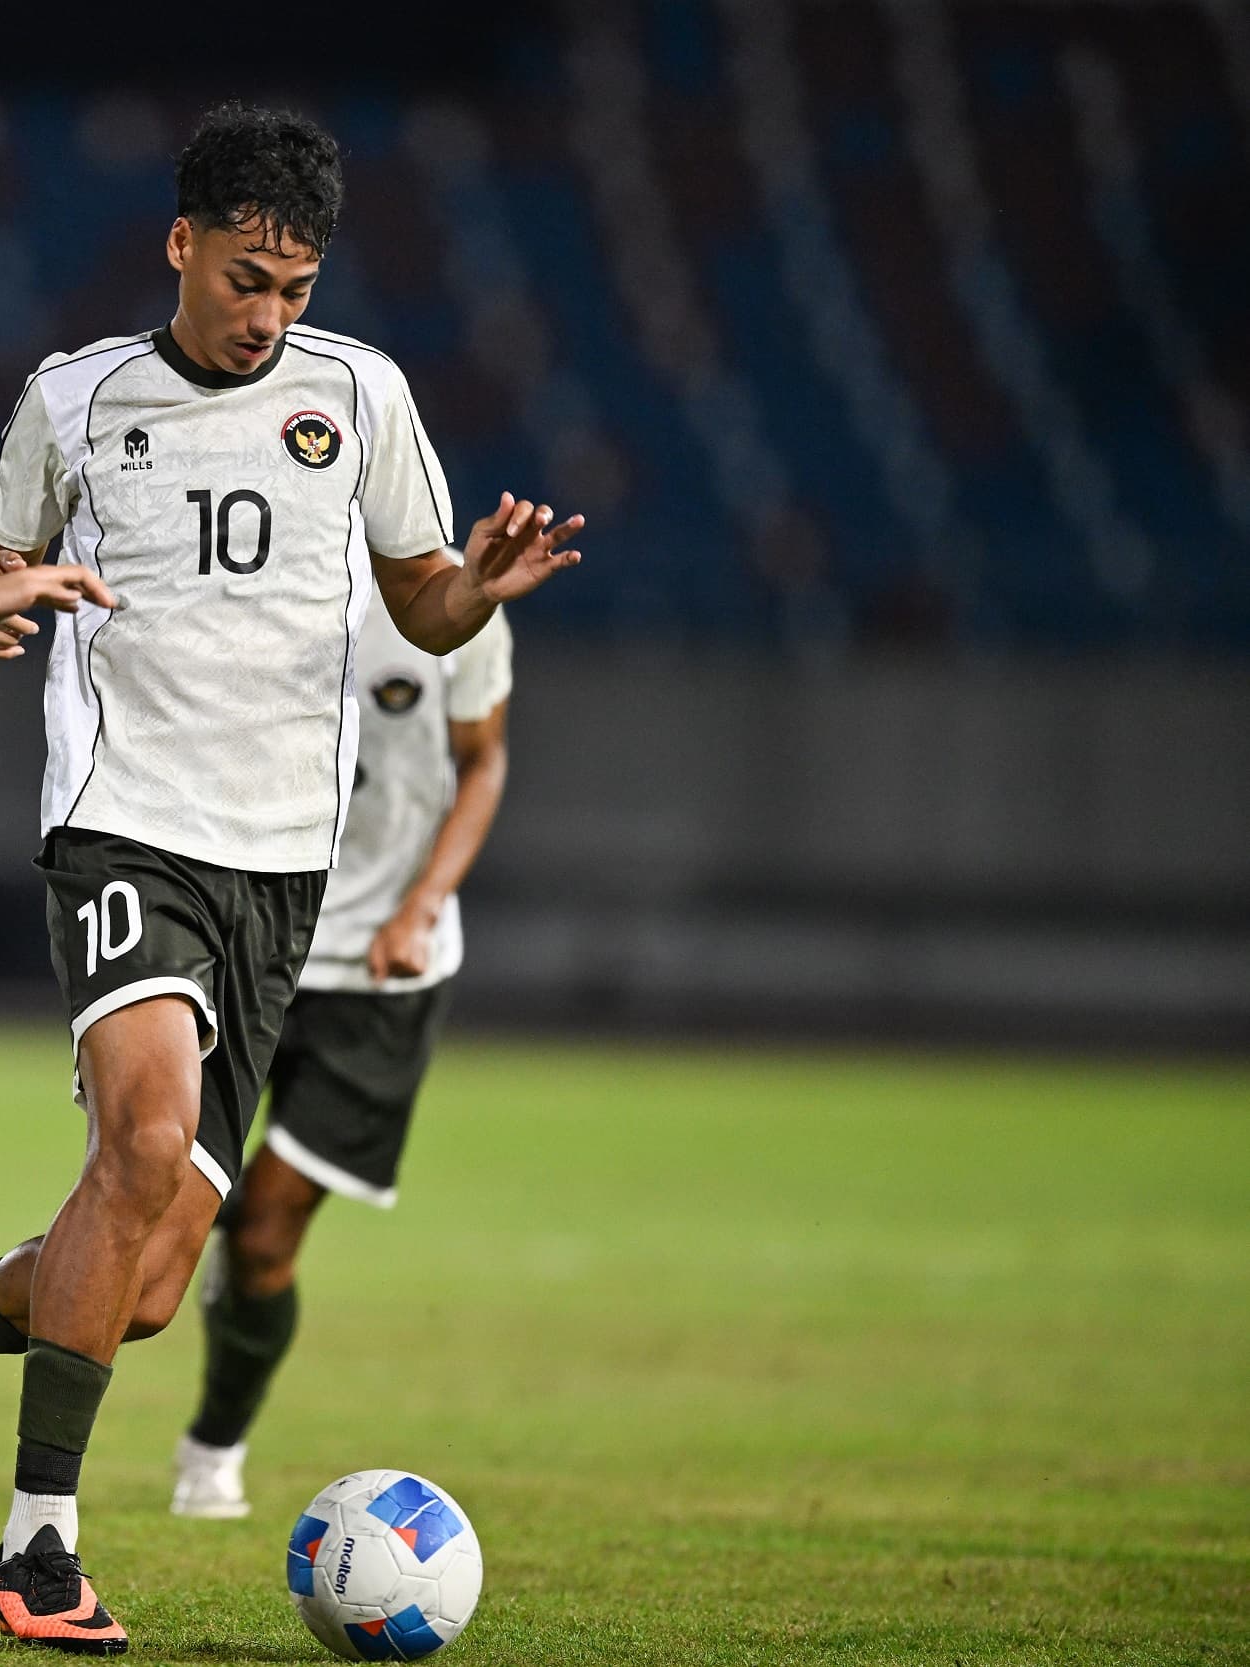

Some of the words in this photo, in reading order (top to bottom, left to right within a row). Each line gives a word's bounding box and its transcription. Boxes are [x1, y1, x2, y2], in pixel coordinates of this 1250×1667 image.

[120, 461, 153, 472] MILLS
[186, 489, 272, 576] 10
[76, 880, 143, 977] 10
[335, 1537, 355, 1594] molten
